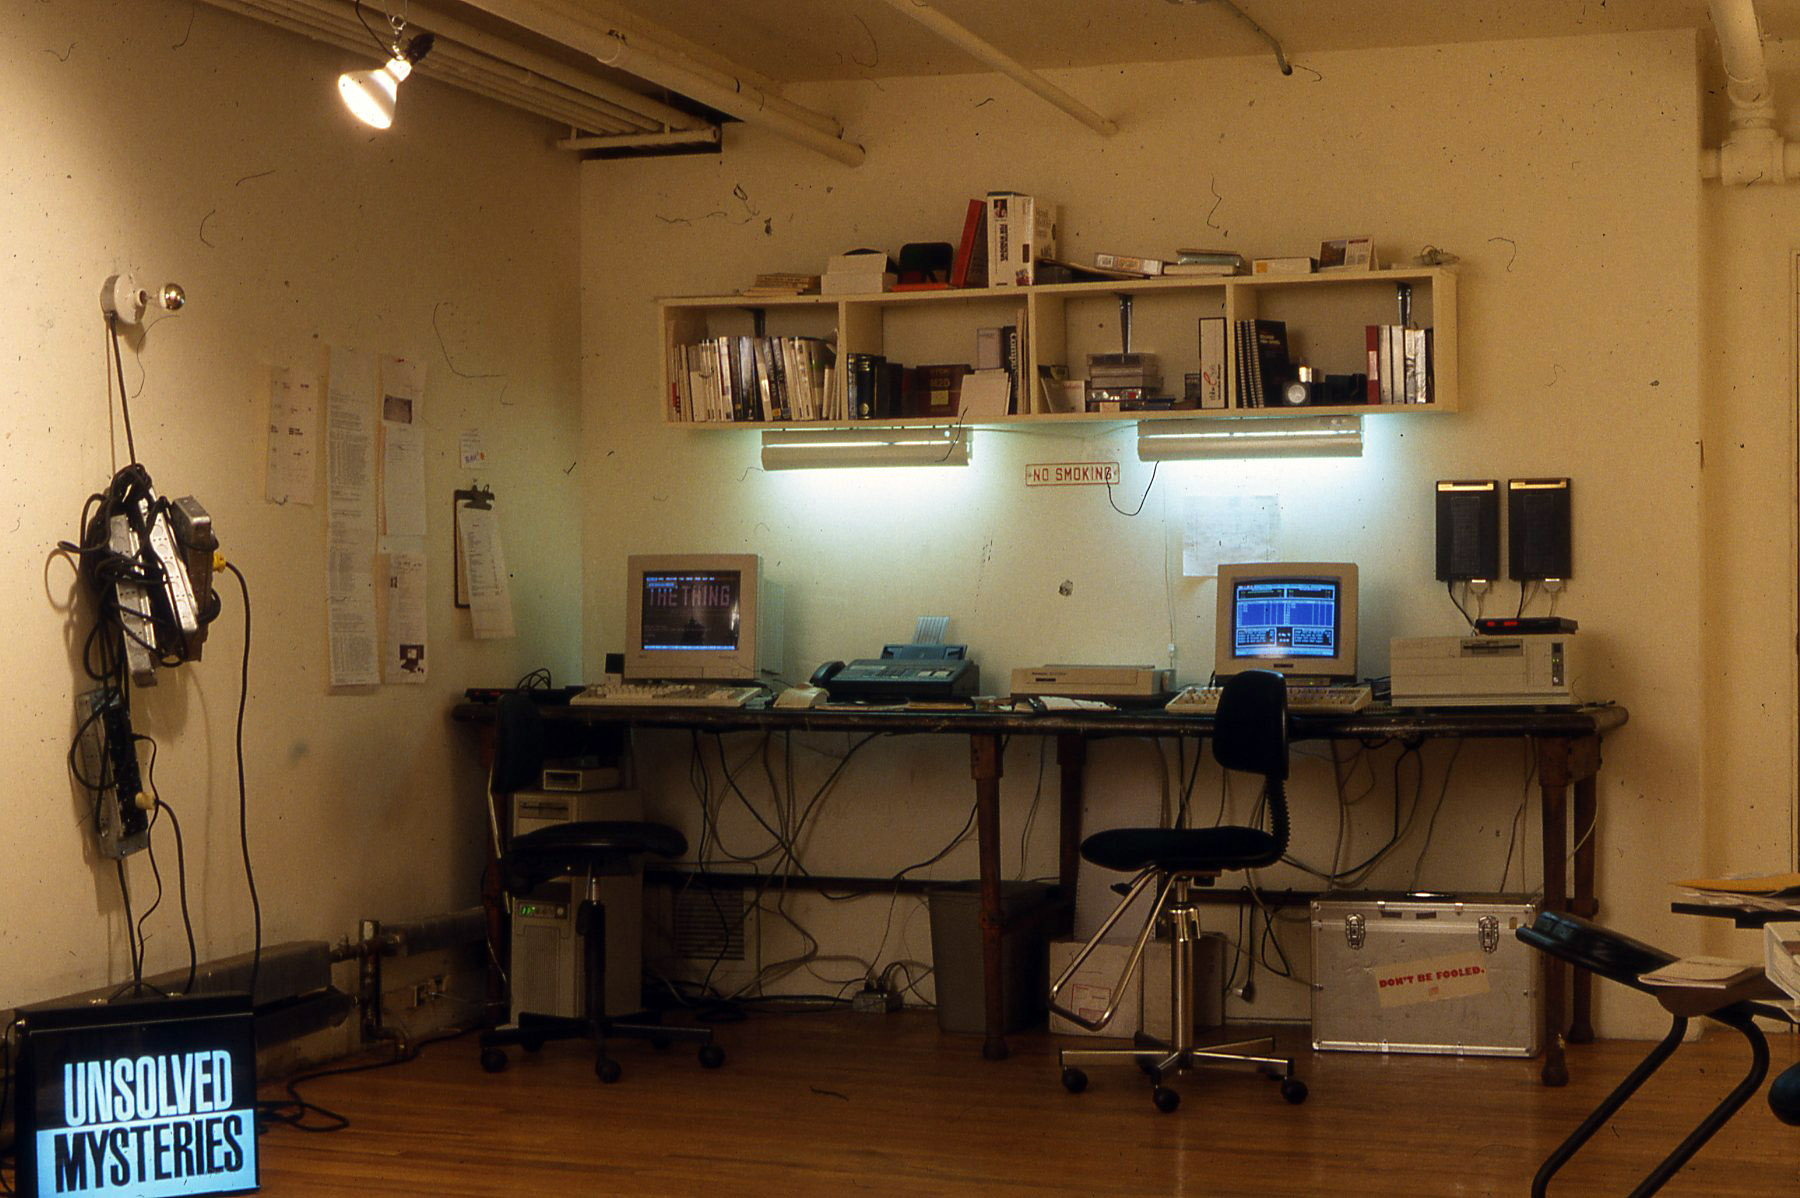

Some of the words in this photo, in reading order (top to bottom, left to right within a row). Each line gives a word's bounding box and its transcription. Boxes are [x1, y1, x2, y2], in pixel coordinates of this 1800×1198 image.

[1034, 468, 1048, 481] NO
[1056, 466, 1111, 481] SMOKING
[681, 585, 730, 607] THING
[1379, 976, 1413, 988] DON'T
[1417, 973, 1432, 982] BE
[1436, 966, 1485, 980] FOOLED.
[64, 1050, 232, 1127] UNSOLVED
[54, 1115, 243, 1193] MYSTERIES
